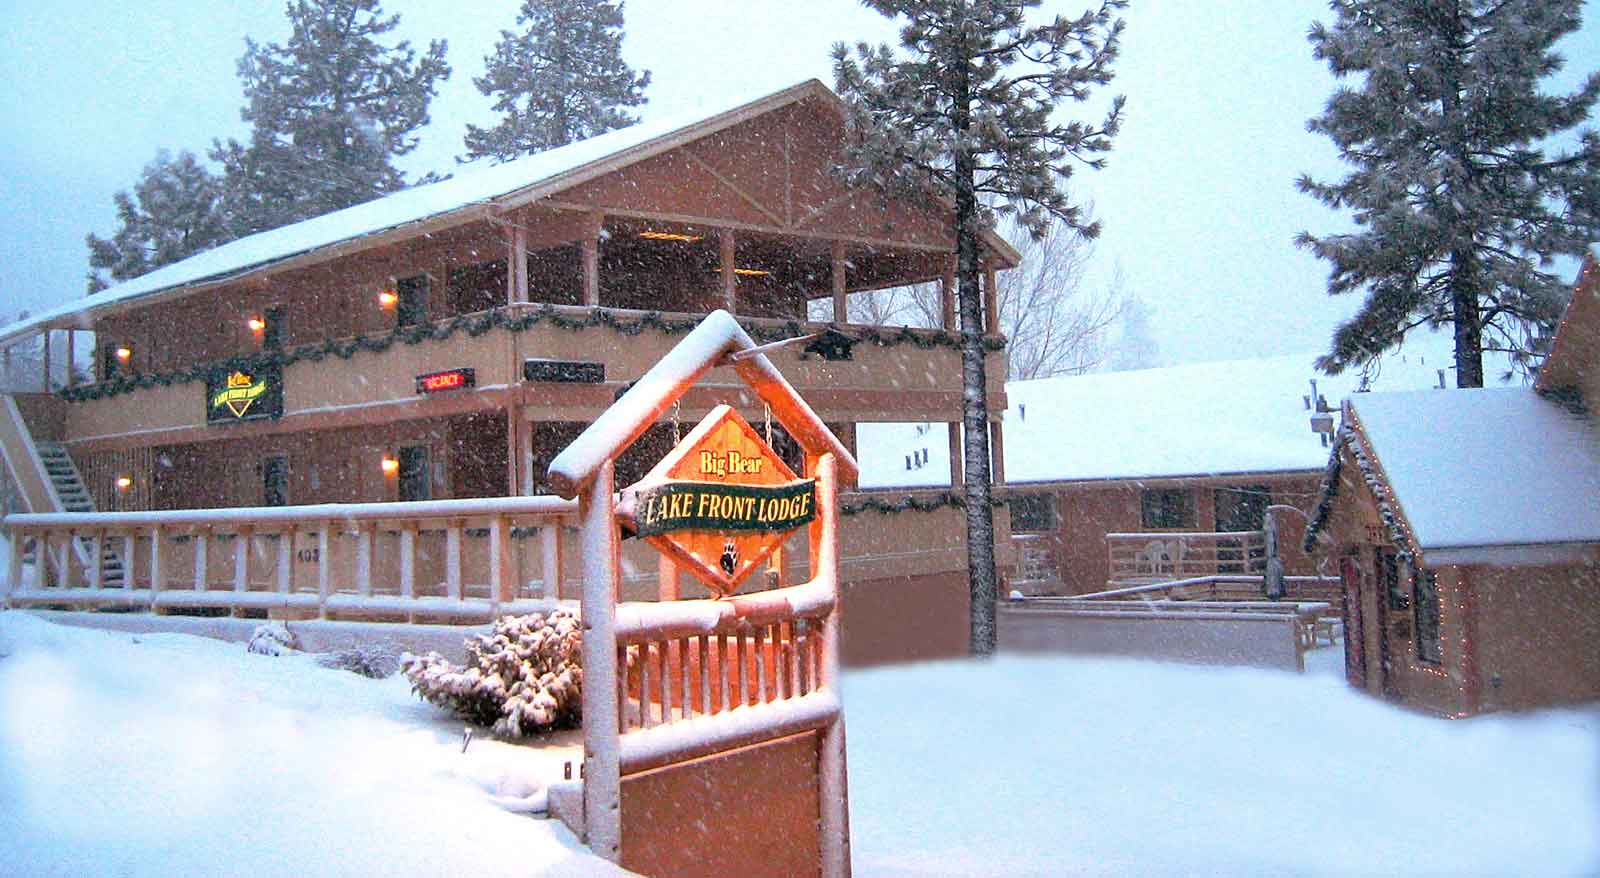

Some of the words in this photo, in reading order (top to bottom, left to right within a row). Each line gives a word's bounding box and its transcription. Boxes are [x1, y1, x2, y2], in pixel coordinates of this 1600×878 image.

[700, 451, 726, 477] Big
[728, 451, 763, 474] Bear
[646, 492, 694, 525] LAKE
[697, 493, 757, 521] FRONT
[758, 492, 812, 522] LODGE
